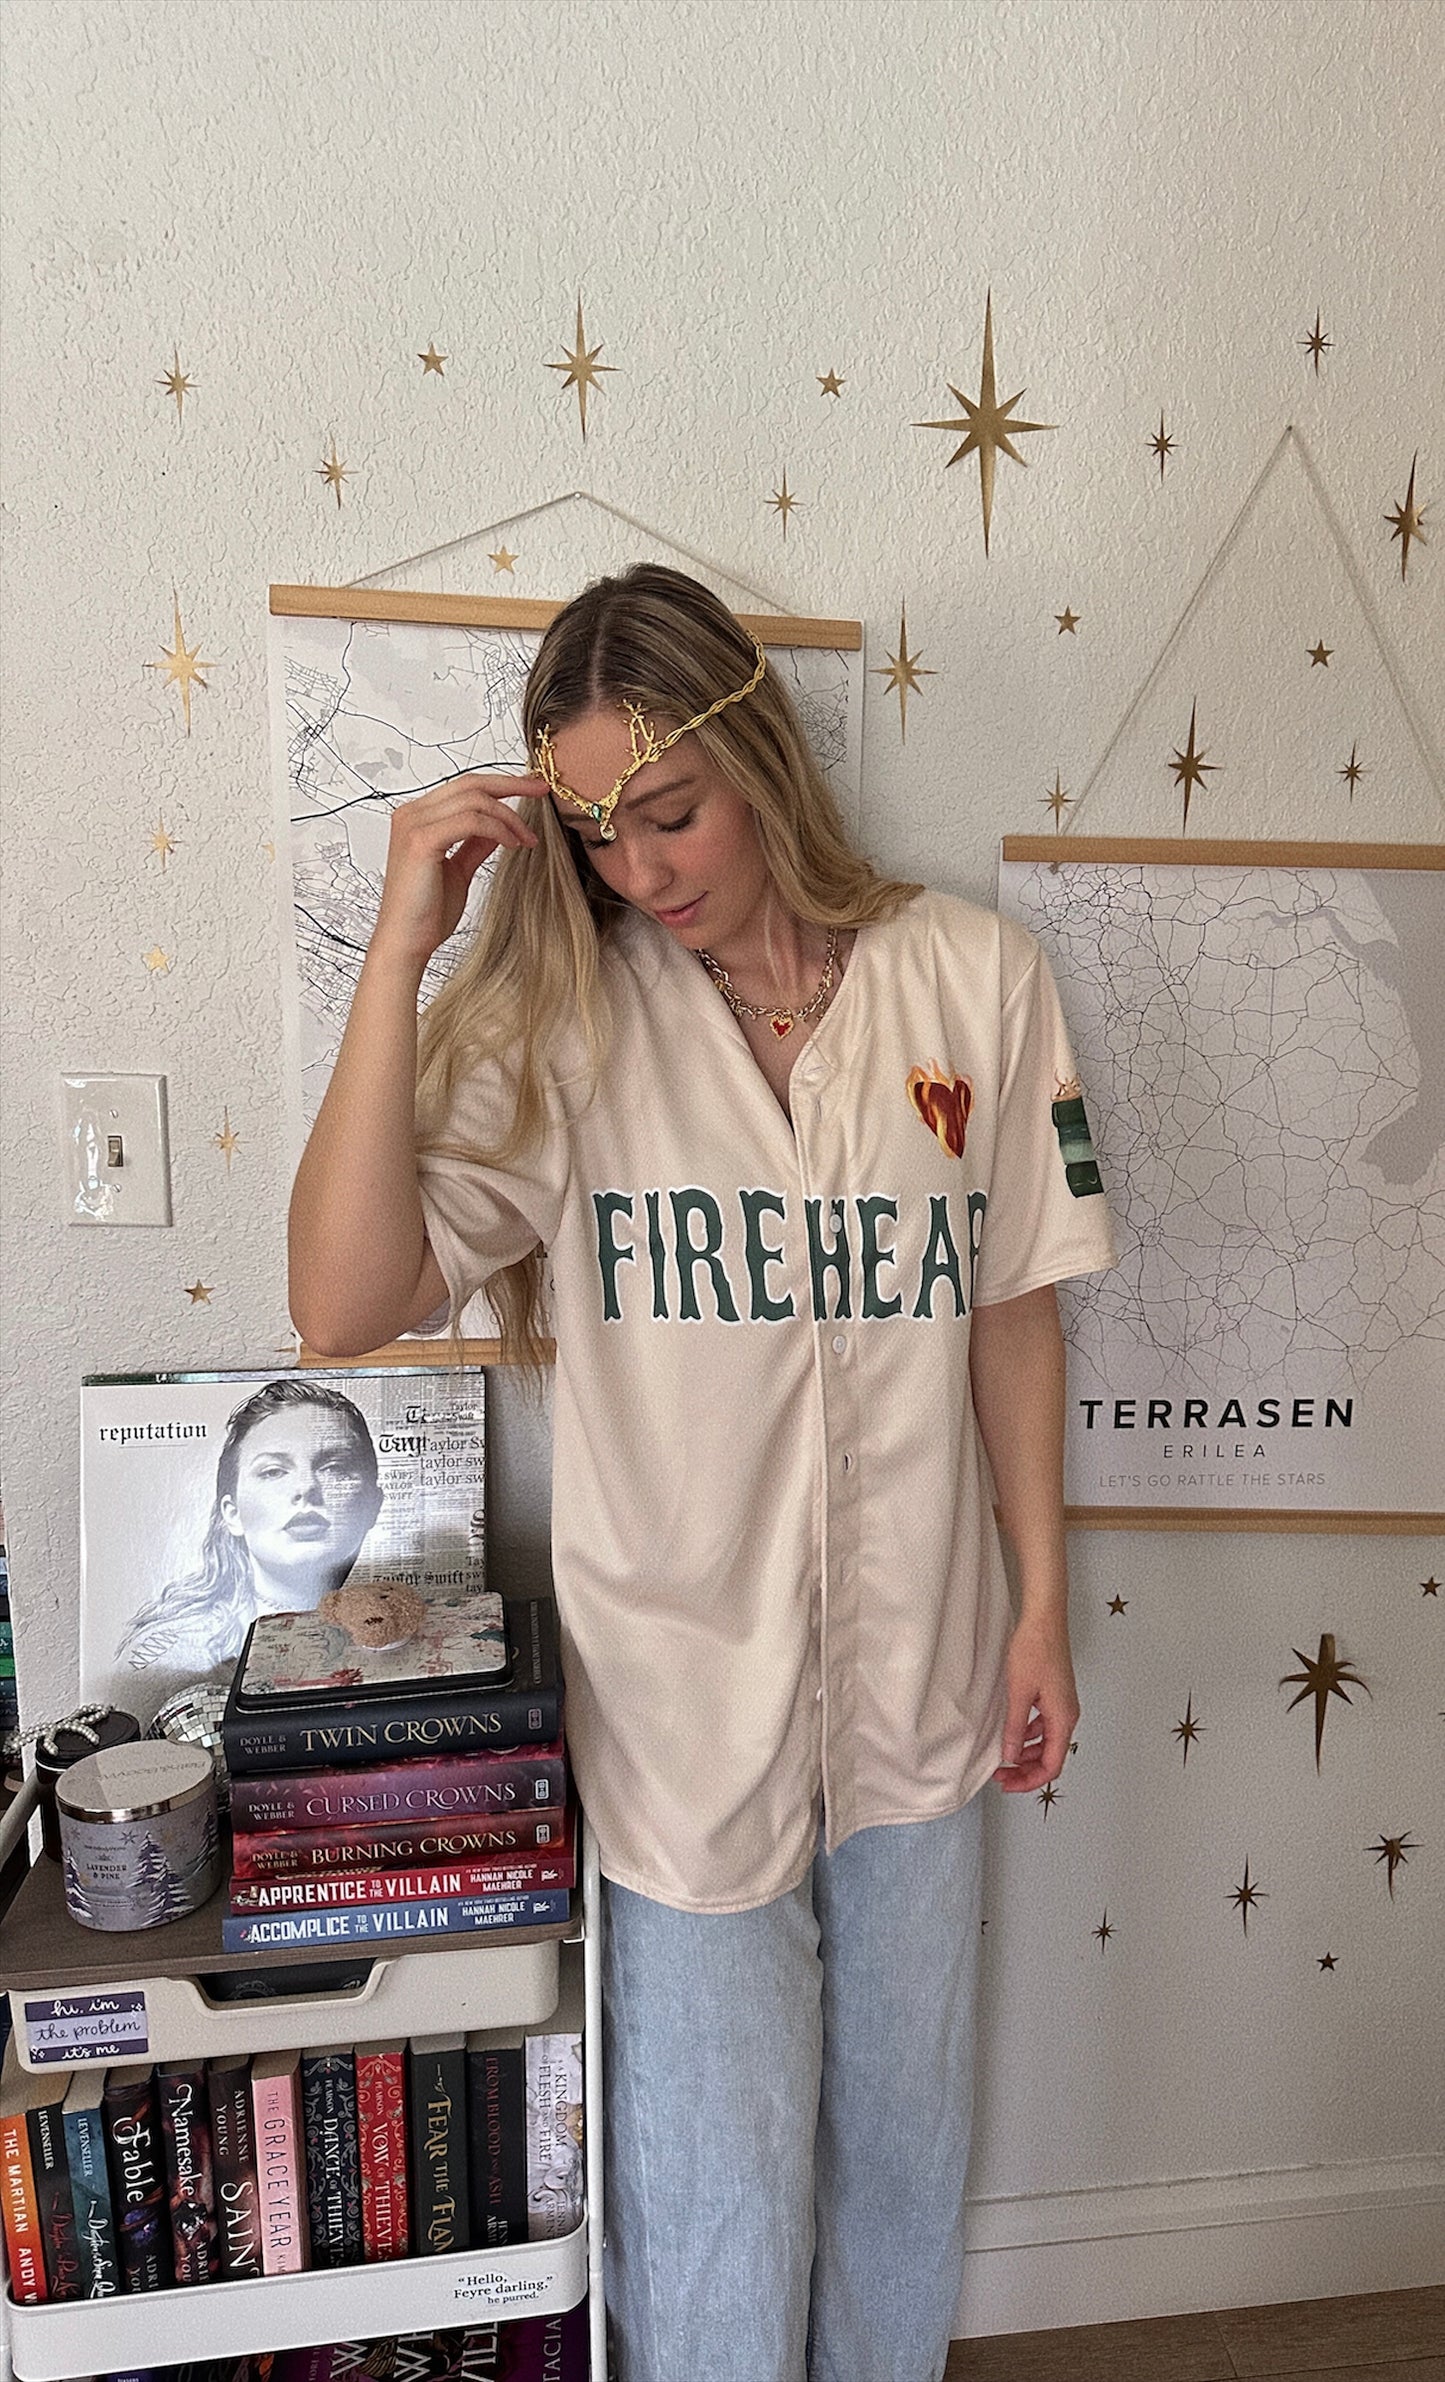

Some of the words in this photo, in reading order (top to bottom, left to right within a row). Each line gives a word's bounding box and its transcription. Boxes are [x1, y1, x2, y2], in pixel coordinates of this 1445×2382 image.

[1079, 1397, 1354, 1430] TERRASEN
[99, 1421, 207, 1446] reputation
[420, 1455, 463, 1472] taylor
[465, 1457, 485, 1467] sw
[1163, 1443, 1267, 1459] ERILEA
[420, 1472, 463, 1489] taylor
[465, 1474, 485, 1484] sw
[1100, 1474, 1141, 1488] LET'S
[1148, 1474, 1171, 1488] GO
[1178, 1474, 1234, 1487] RATTLE
[1242, 1473, 1270, 1487] THE
[1277, 1472, 1326, 1486] STARS
[240, 1735, 272, 1746] DOYLE
[300, 1724, 378, 1752] TWIN
[384, 1712, 502, 1745] CROWNS
[245, 1744, 287, 1755] WEBBER
[249, 1803, 282, 1813] DOYLE
[306, 1791, 400, 1816] CURSED
[405, 1782, 516, 1810] CROWNS
[254, 1811, 295, 1821] WEBBER
[252, 1852, 286, 1863] DOYLE
[312, 1840, 413, 1865] BURNING
[420, 1831, 517, 1855] CROWNS
[86, 1863, 127, 1872] LAVENDER
[256, 1860, 298, 1870] WEBBER
[470, 1872, 504, 1883] HANNAH
[506, 1869, 534, 1881] NICOLE
[258, 1880, 367, 1907] APPRENTICE
[370, 1887, 384, 1898] THE
[371, 1880, 382, 1889] TO
[385, 1873, 462, 1897] VILLAIN
[482, 1880, 523, 1892] MAEHRER
[356, 1915, 368, 1924] TO
[372, 1907, 449, 1932] VILLAIN
[462, 1904, 496, 1916] HANNAH
[498, 1901, 526, 1913] NICOLE
[474, 1913, 515, 1926] MAEHRER
[250, 1916, 350, 1943] ACCOMPLICE
[355, 1923, 369, 1934] THE
[36, 2023, 68, 2041] the
[74, 2018, 141, 2040] problem
[62, 2047, 92, 2060] it's
[96, 2045, 120, 2054] me
[485, 2056, 500, 2101] FROM
[538, 2064, 551, 2109] FLESH
[267, 2091, 280, 2113] THE
[324, 2079, 335, 2114] PEARSON
[554, 2073, 568, 2148] KINGDOM
[215, 2105, 229, 2156] YOUNG
[234, 2089, 249, 2163] ADRIENNE
[424, 2094, 453, 2160] FEAR
[486, 2103, 500, 2156] BLOOD
[3, 2128, 19, 2159] THE
[38, 2110, 54, 2170] LEVENSELLER
[77, 2118, 94, 2178] LEVENSELLER
[168, 2083, 203, 2197] Namesake
[320, 2117, 341, 2179] DANCE
[371, 2122, 390, 2167] VOW
[539, 2129, 552, 2161] FIRE
[112, 2116, 156, 2203] Fable
[263, 2118, 289, 2191] GRACE
[433, 2161, 449, 2193] THE
[489, 2175, 503, 2205] ASH
[8, 2164, 29, 2233] MARTIAN
[269, 2196, 292, 2249] YEAR
[18, 2248, 37, 2287] ANDY
[145, 2254, 159, 2289] ADRI
[181, 2254, 192, 2282] YOU
[454, 2288, 491, 2300] Feyre
[488, 2296, 500, 2304] he
[503, 2291, 540, 2304] purred.
[542, 2318, 562, 2382] TACIA
